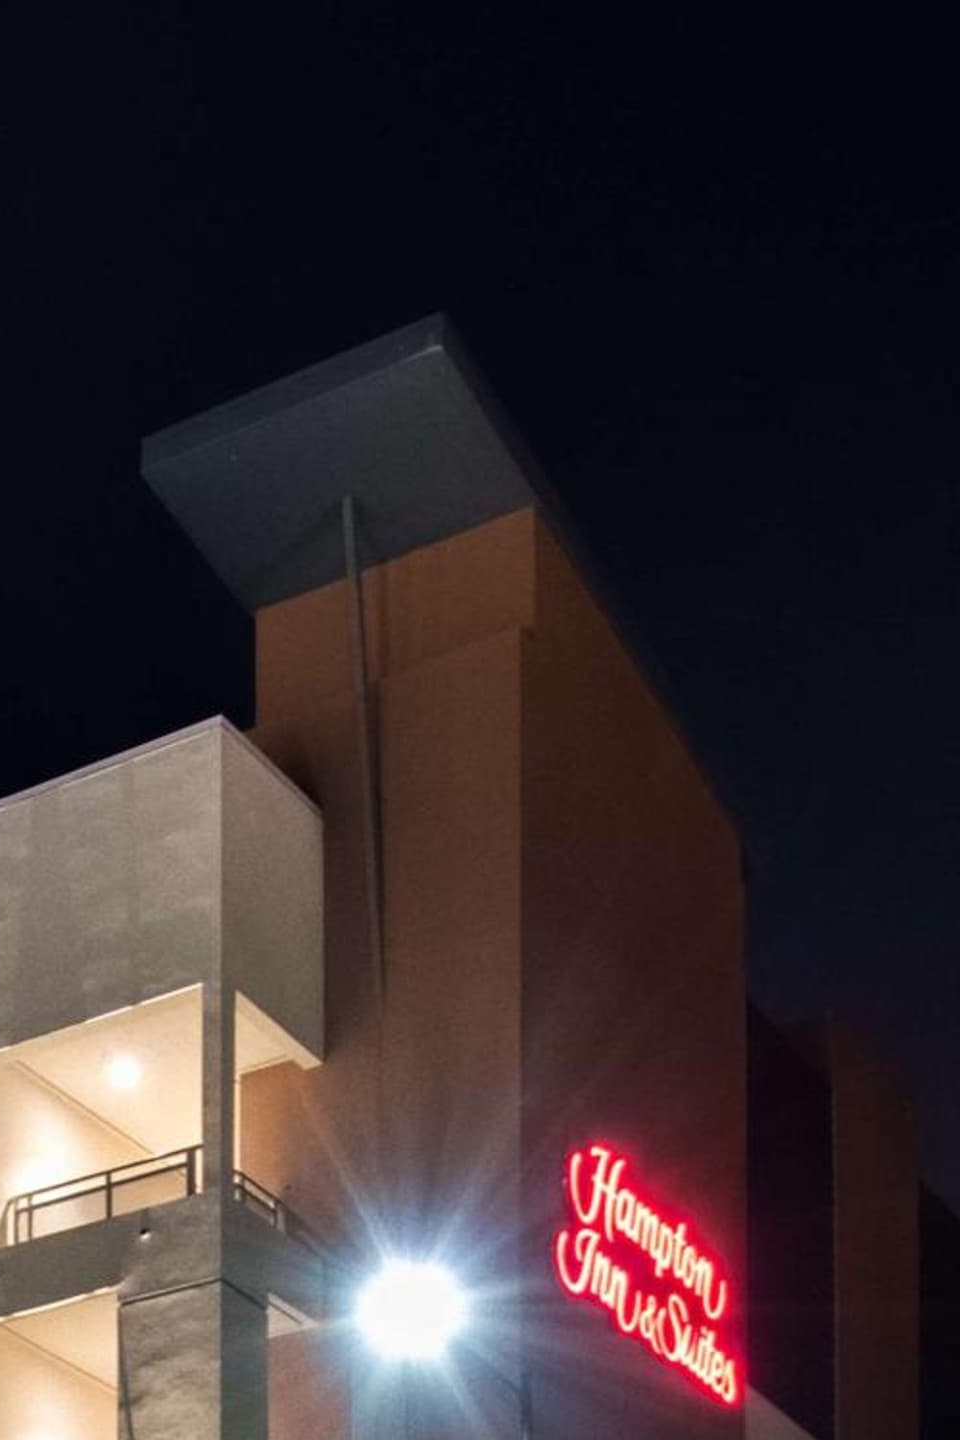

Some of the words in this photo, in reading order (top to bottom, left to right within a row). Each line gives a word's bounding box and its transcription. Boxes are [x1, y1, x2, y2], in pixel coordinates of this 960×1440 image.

[556, 1229, 642, 1333] Inn
[640, 1295, 662, 1355] &
[656, 1293, 736, 1404] Suites
[570, 1146, 727, 1321] Hampton
